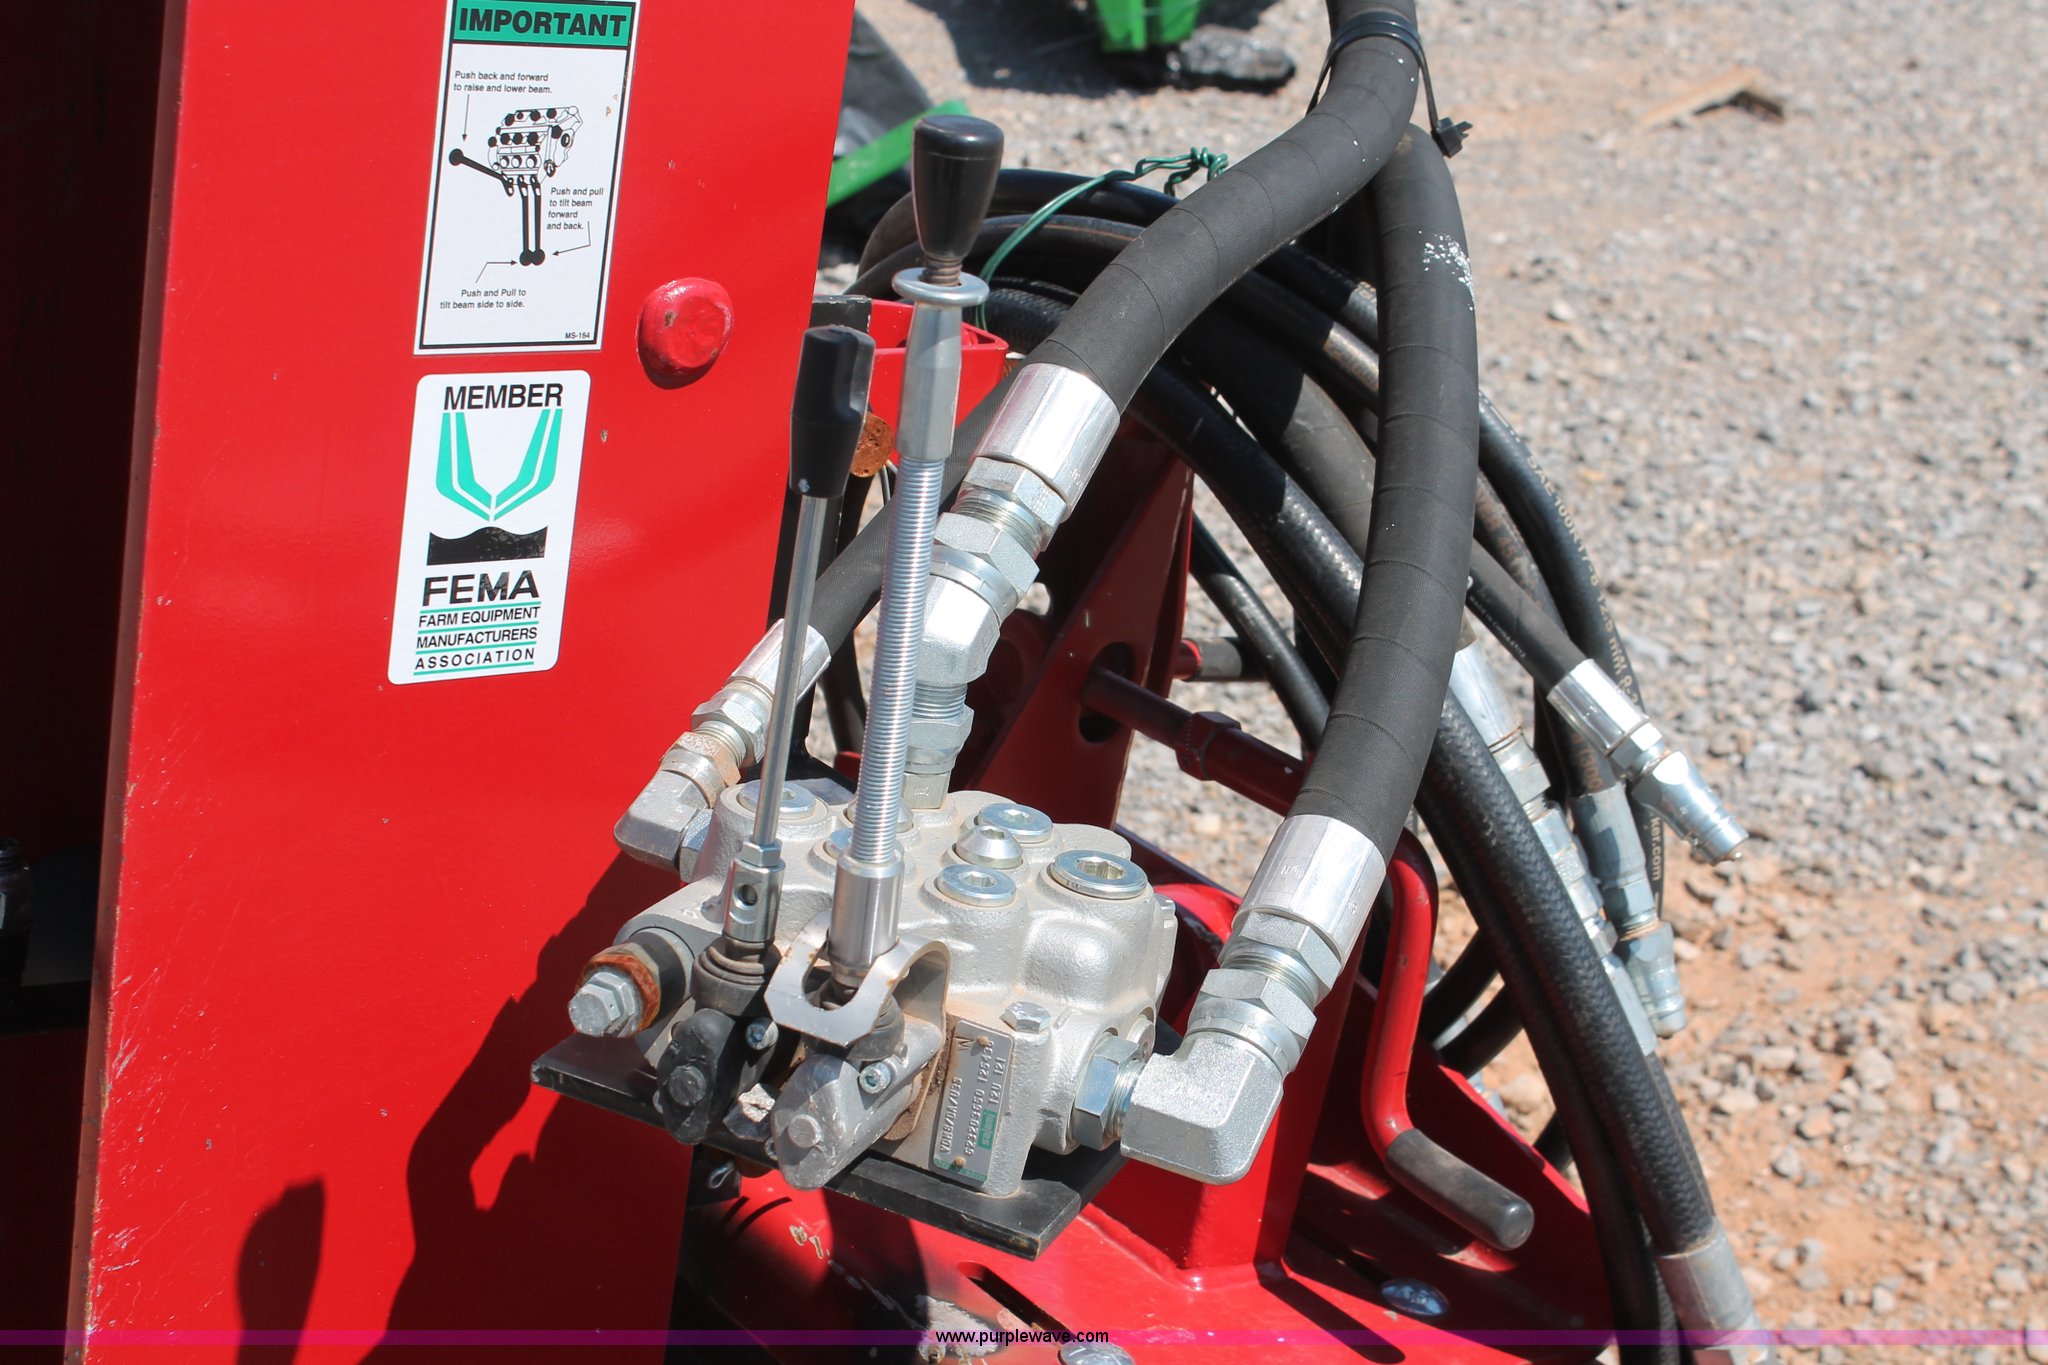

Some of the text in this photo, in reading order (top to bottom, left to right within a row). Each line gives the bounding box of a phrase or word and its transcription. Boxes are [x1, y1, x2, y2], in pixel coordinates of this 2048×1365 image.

[458, 8, 626, 37] IMPORTANT
[455, 70, 549, 81] Push back and forward
[453, 83, 552, 94] to raise and lower beam.
[551, 187, 604, 197] Push and pull
[549, 199, 592, 207] to tilt beam
[548, 210, 578, 218] forward
[546, 221, 584, 230] and back.
[460, 288, 526, 298] Push and Pull to
[440, 299, 525, 309] tilt beam side to side.
[443, 382, 563, 411] MEMBER
[1527, 454, 1556, 496] SAE
[422, 569, 540, 607] FEMA
[418, 606, 541, 628] FARM EQUIPMENT
[416, 627, 538, 649] MANUFACTURERS
[415, 648, 535, 670] ASSOCIATION
[1650, 812, 1662, 881] ker.com
